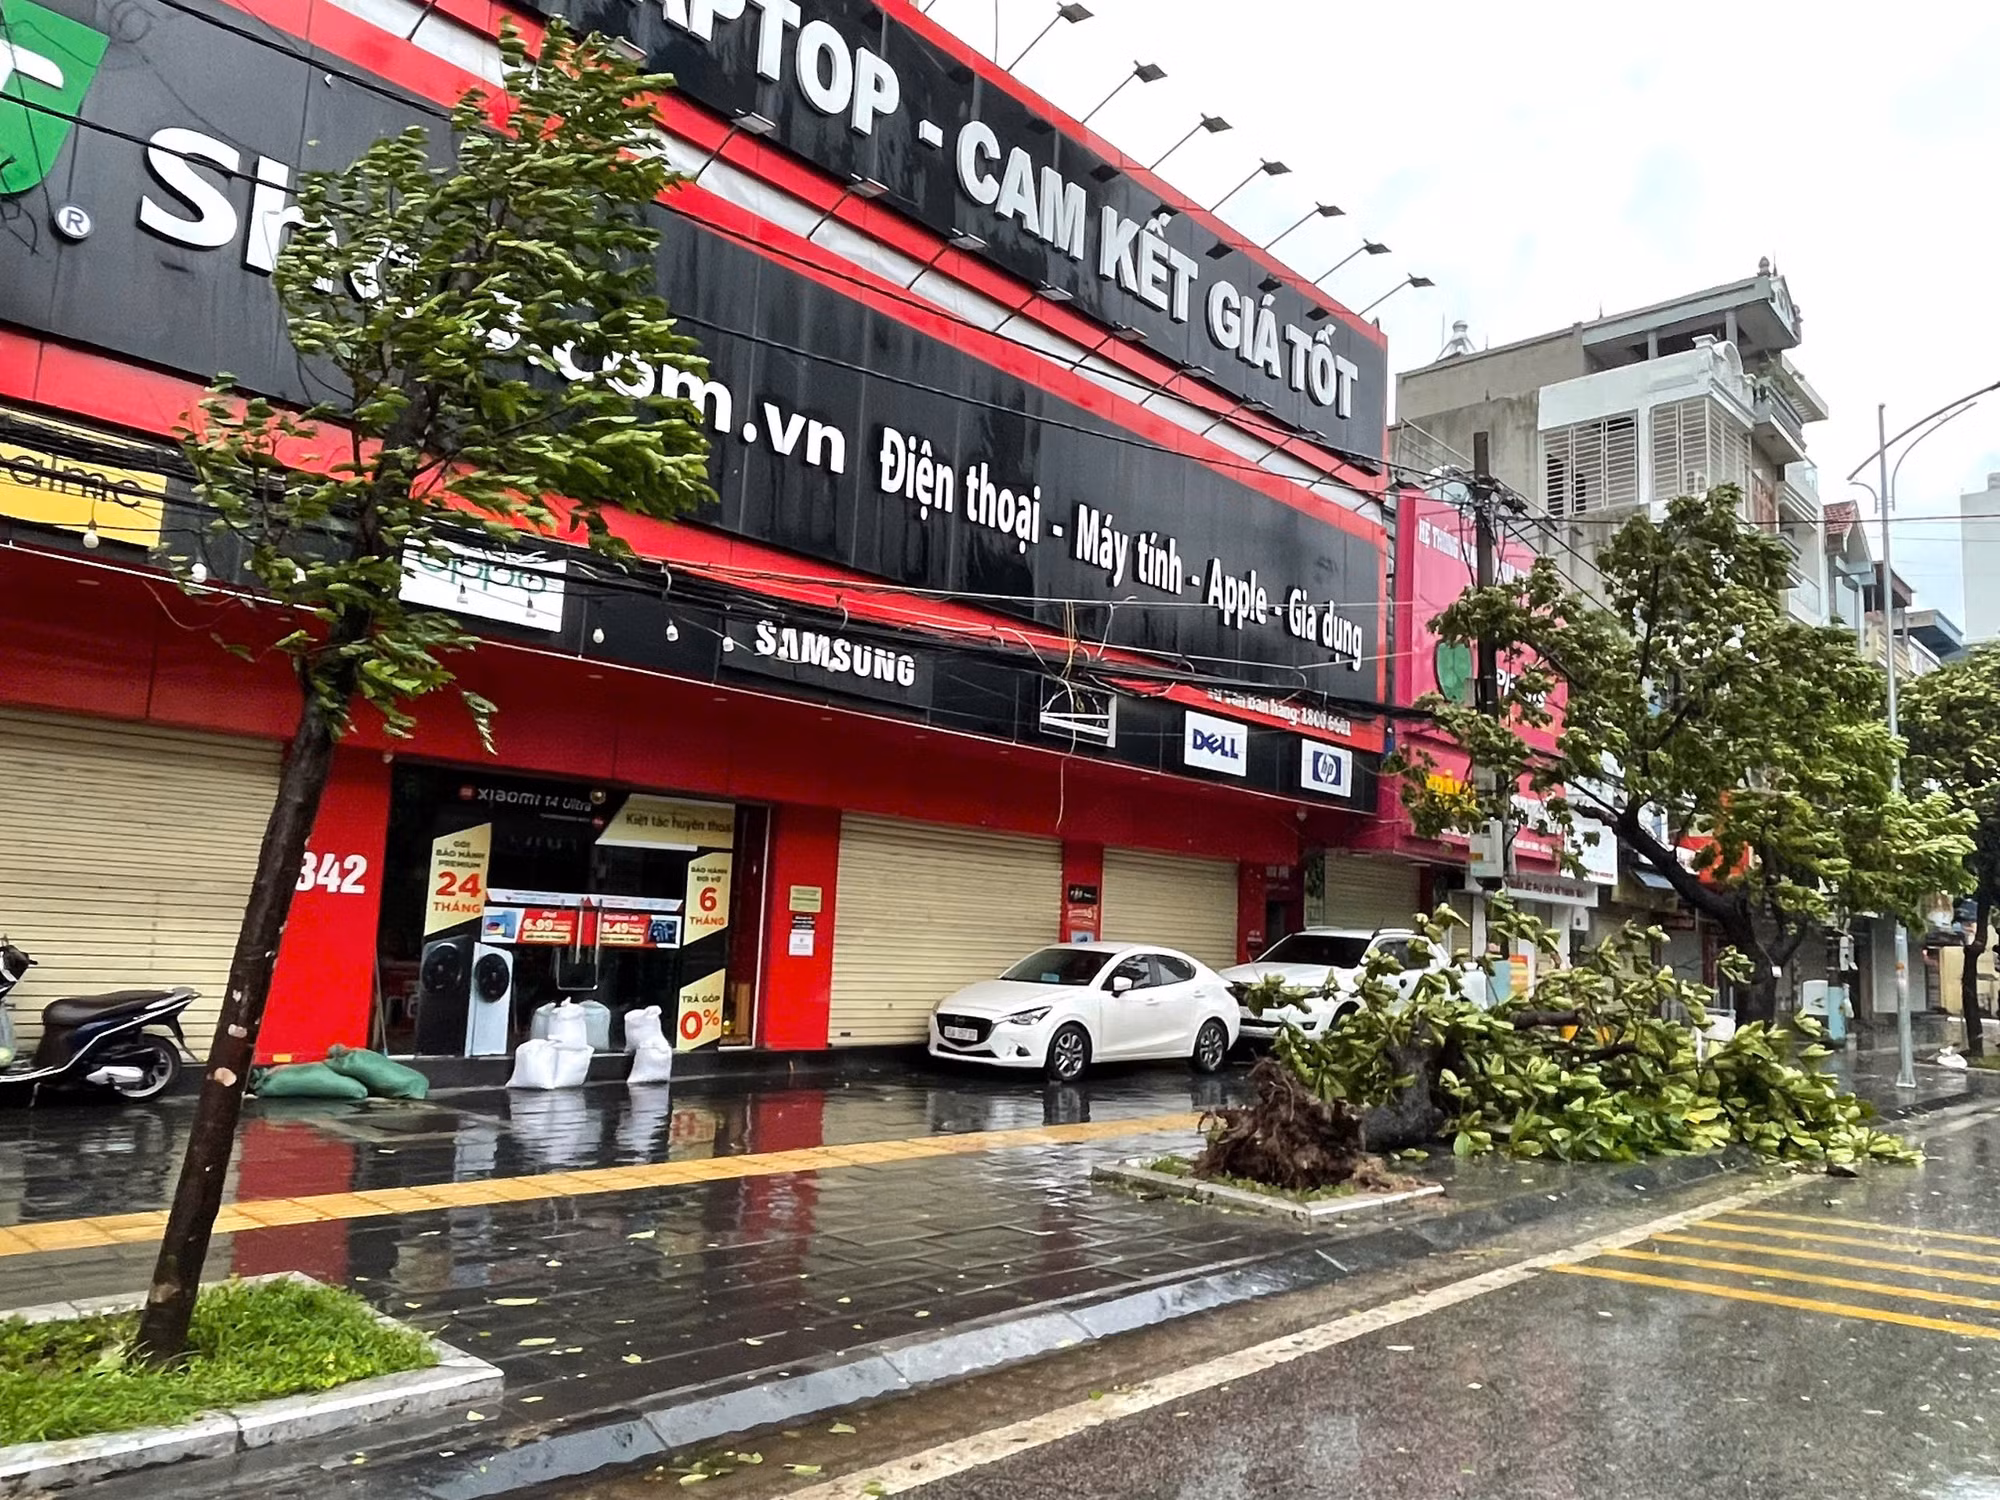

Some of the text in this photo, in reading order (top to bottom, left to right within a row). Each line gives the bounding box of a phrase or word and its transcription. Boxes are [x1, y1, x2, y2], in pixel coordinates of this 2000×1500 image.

[956, 120, 1087, 261] CAM
[1099, 205, 1199, 324] KẾT
[1208, 279, 1281, 380] GIÁ
[1284, 322, 1359, 420] TỐT
[879, 426, 955, 521] Điện
[965, 461, 1042, 554] thoại
[1076, 504, 1129, 587] Máy
[1137, 531, 1183, 595] tính
[1207, 557, 1268, 630] Apple
[1288, 588, 1317, 643] Gia
[1322, 600, 1363, 672] dụng
[754, 619, 916, 688] SAMSUNG
[1300, 706, 1327, 730] 1800
[1192, 728, 1240, 761] DELL
[294, 851, 368, 895] 342
[435, 871, 482, 898] 24
[433, 900, 482, 913] THÁNG
[699, 886, 717, 912] 6
[680, 1008, 720, 1041] 0%
